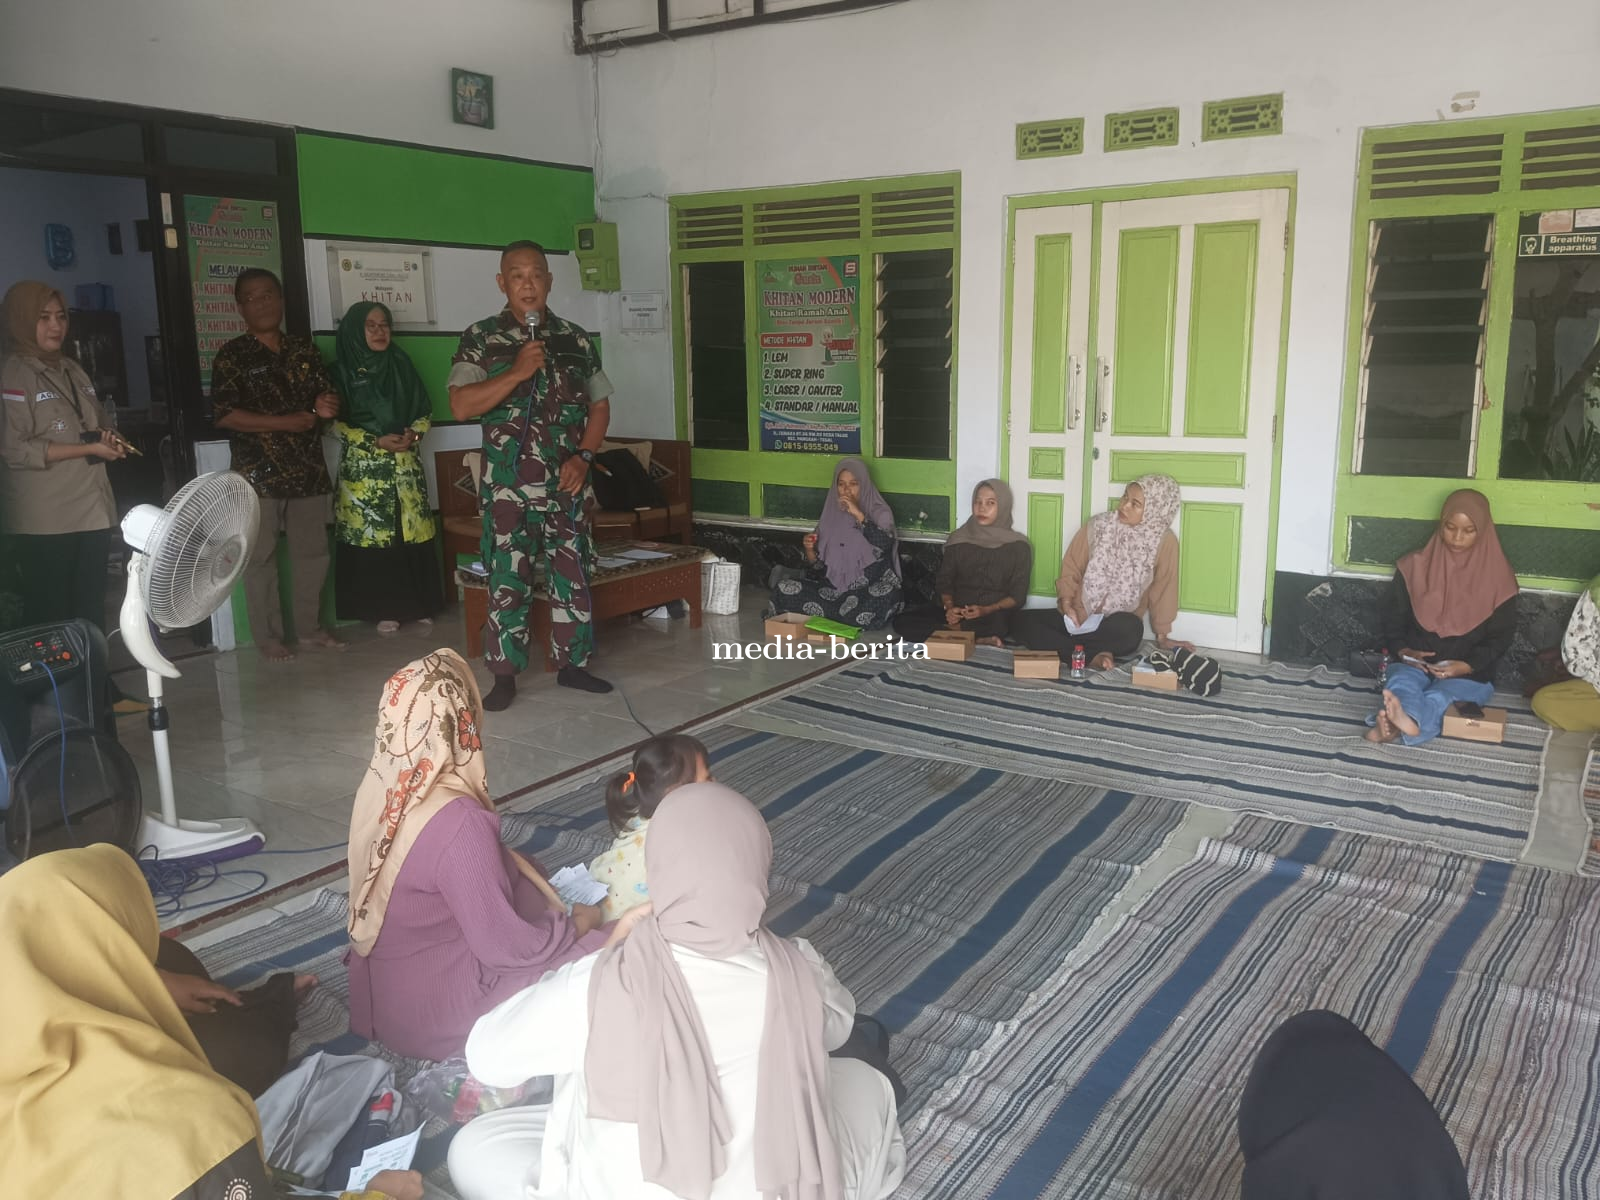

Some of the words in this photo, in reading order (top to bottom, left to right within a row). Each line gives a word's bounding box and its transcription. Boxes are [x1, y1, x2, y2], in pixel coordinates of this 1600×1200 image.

[187, 221, 228, 238] KHITAN
[233, 227, 273, 241] MODERN
[1550, 235, 1598, 244] Breathing
[1548, 244, 1598, 253] apparatus
[204, 282, 235, 295] KHITAN
[361, 291, 412, 303] KHITAN
[764, 290, 804, 306] KHITAN
[808, 287, 856, 305] MODERN
[205, 302, 236, 314] KHITAN
[769, 308, 796, 318] Khitan
[798, 307, 825, 317] Ramah
[827, 306, 849, 316] Anak
[207, 320, 237, 332] KHITAN
[763, 352, 770, 363] 1.
[771, 352, 789, 363] LEM
[763, 369, 771, 379] 2.
[773, 368, 802, 379] SUPER
[804, 368, 825, 379] RING
[764, 385, 772, 395] 3.
[774, 385, 800, 395] LASER
[764, 401, 773, 411] 4.
[774, 401, 814, 412] STANDAR
[821, 402, 858, 413] MANUAL
